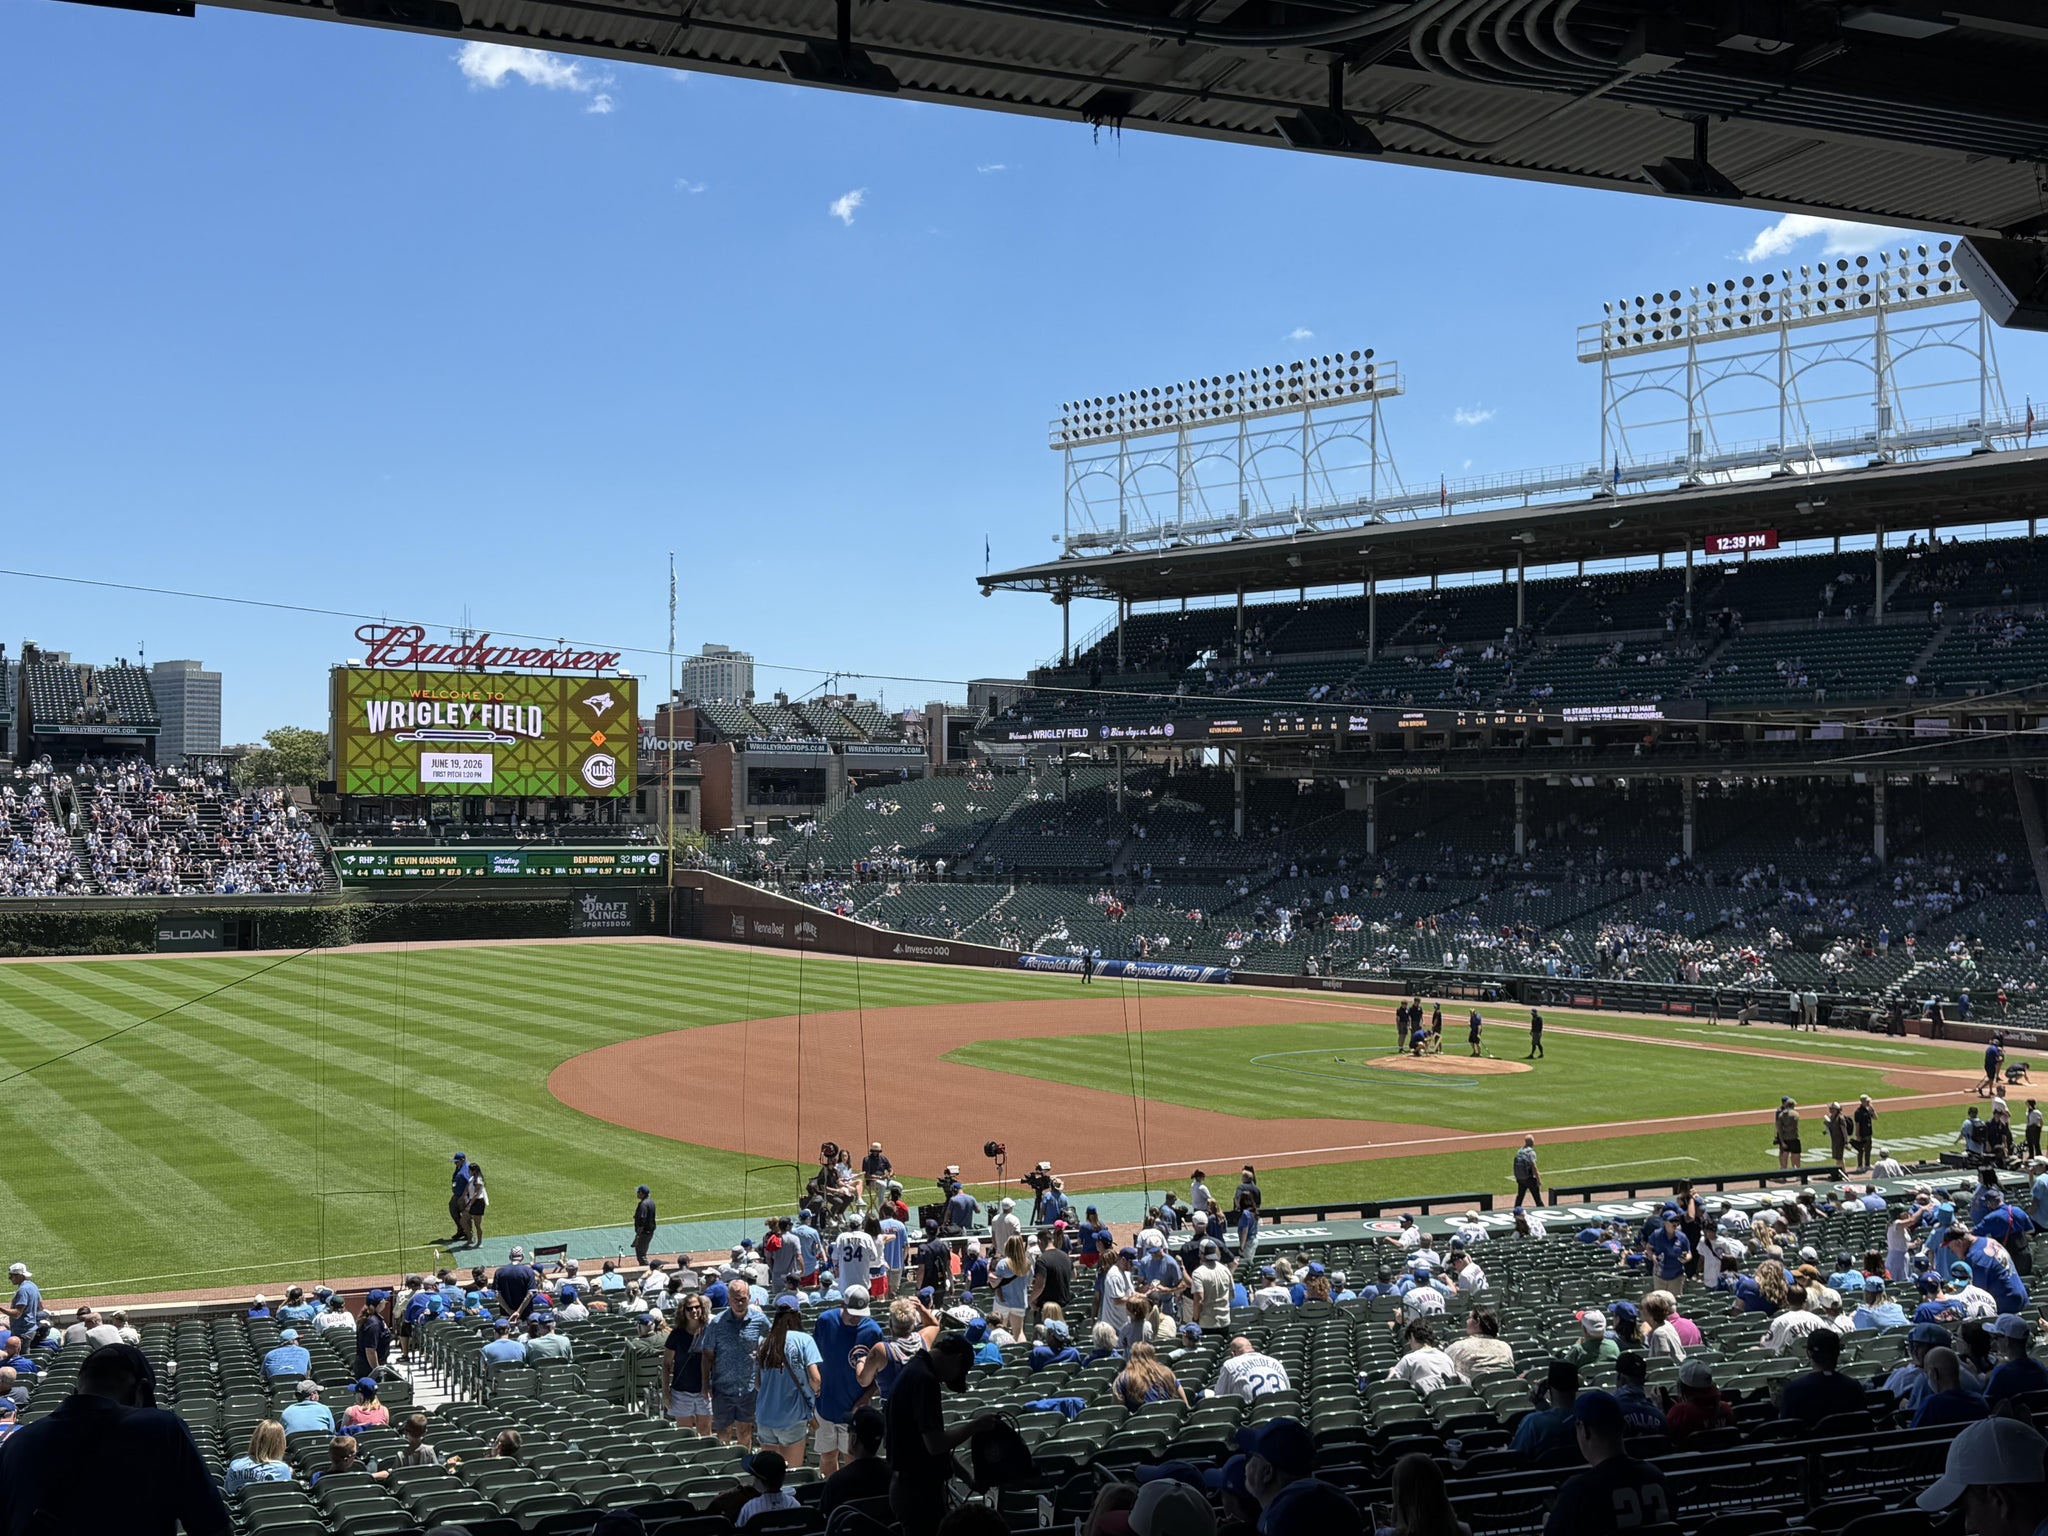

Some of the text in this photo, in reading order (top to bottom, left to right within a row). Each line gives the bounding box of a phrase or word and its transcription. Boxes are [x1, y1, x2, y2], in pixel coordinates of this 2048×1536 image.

[1716, 534, 1766, 550] 12:39 PM
[354, 624, 621, 669] Budweiser
[409, 689, 505, 701] WELCOME TO
[1592, 706, 1617, 714] NEAREST
[366, 700, 542, 738] WRIGLEY FIELD
[1033, 729, 1066, 740] WRIGLEY
[1067, 728, 1089, 738] FIELD
[1110, 726, 1124, 737] Blue
[1126, 726, 1140, 739] Jays
[1149, 725, 1163, 735] Cubs
[643, 736, 694, 751] Moore
[431, 758, 483, 770] JUNE 19, 2026
[432, 770, 482, 779] FIRST PITCH 1:20 PM
[359, 855, 457, 865] RHP 34 KEVIN GAUSMAN
[493, 856, 520, 866] Starting
[573, 855, 646, 864] BEN BROWN 32 RHP
[493, 865, 520, 874] Pitchers
[582, 901, 629, 913] DRAFT
[588, 910, 628, 920] KINGS
[582, 920, 632, 928] SPORTSBOOK
[753, 920, 771, 934] Vienna
[771, 922, 785, 938] Beef
[158, 929, 215, 940] SLOAN
[904, 944, 950, 956] Invesco QQQ
[1024, 956, 1086, 972] Reynolds Wra
[1122, 962, 1200, 980] Reynolds Wrap
[843, 1246, 863, 1262] 34
[1249, 1373, 1281, 1398] 23
[1623, 1412, 1661, 1426] PILLAR
